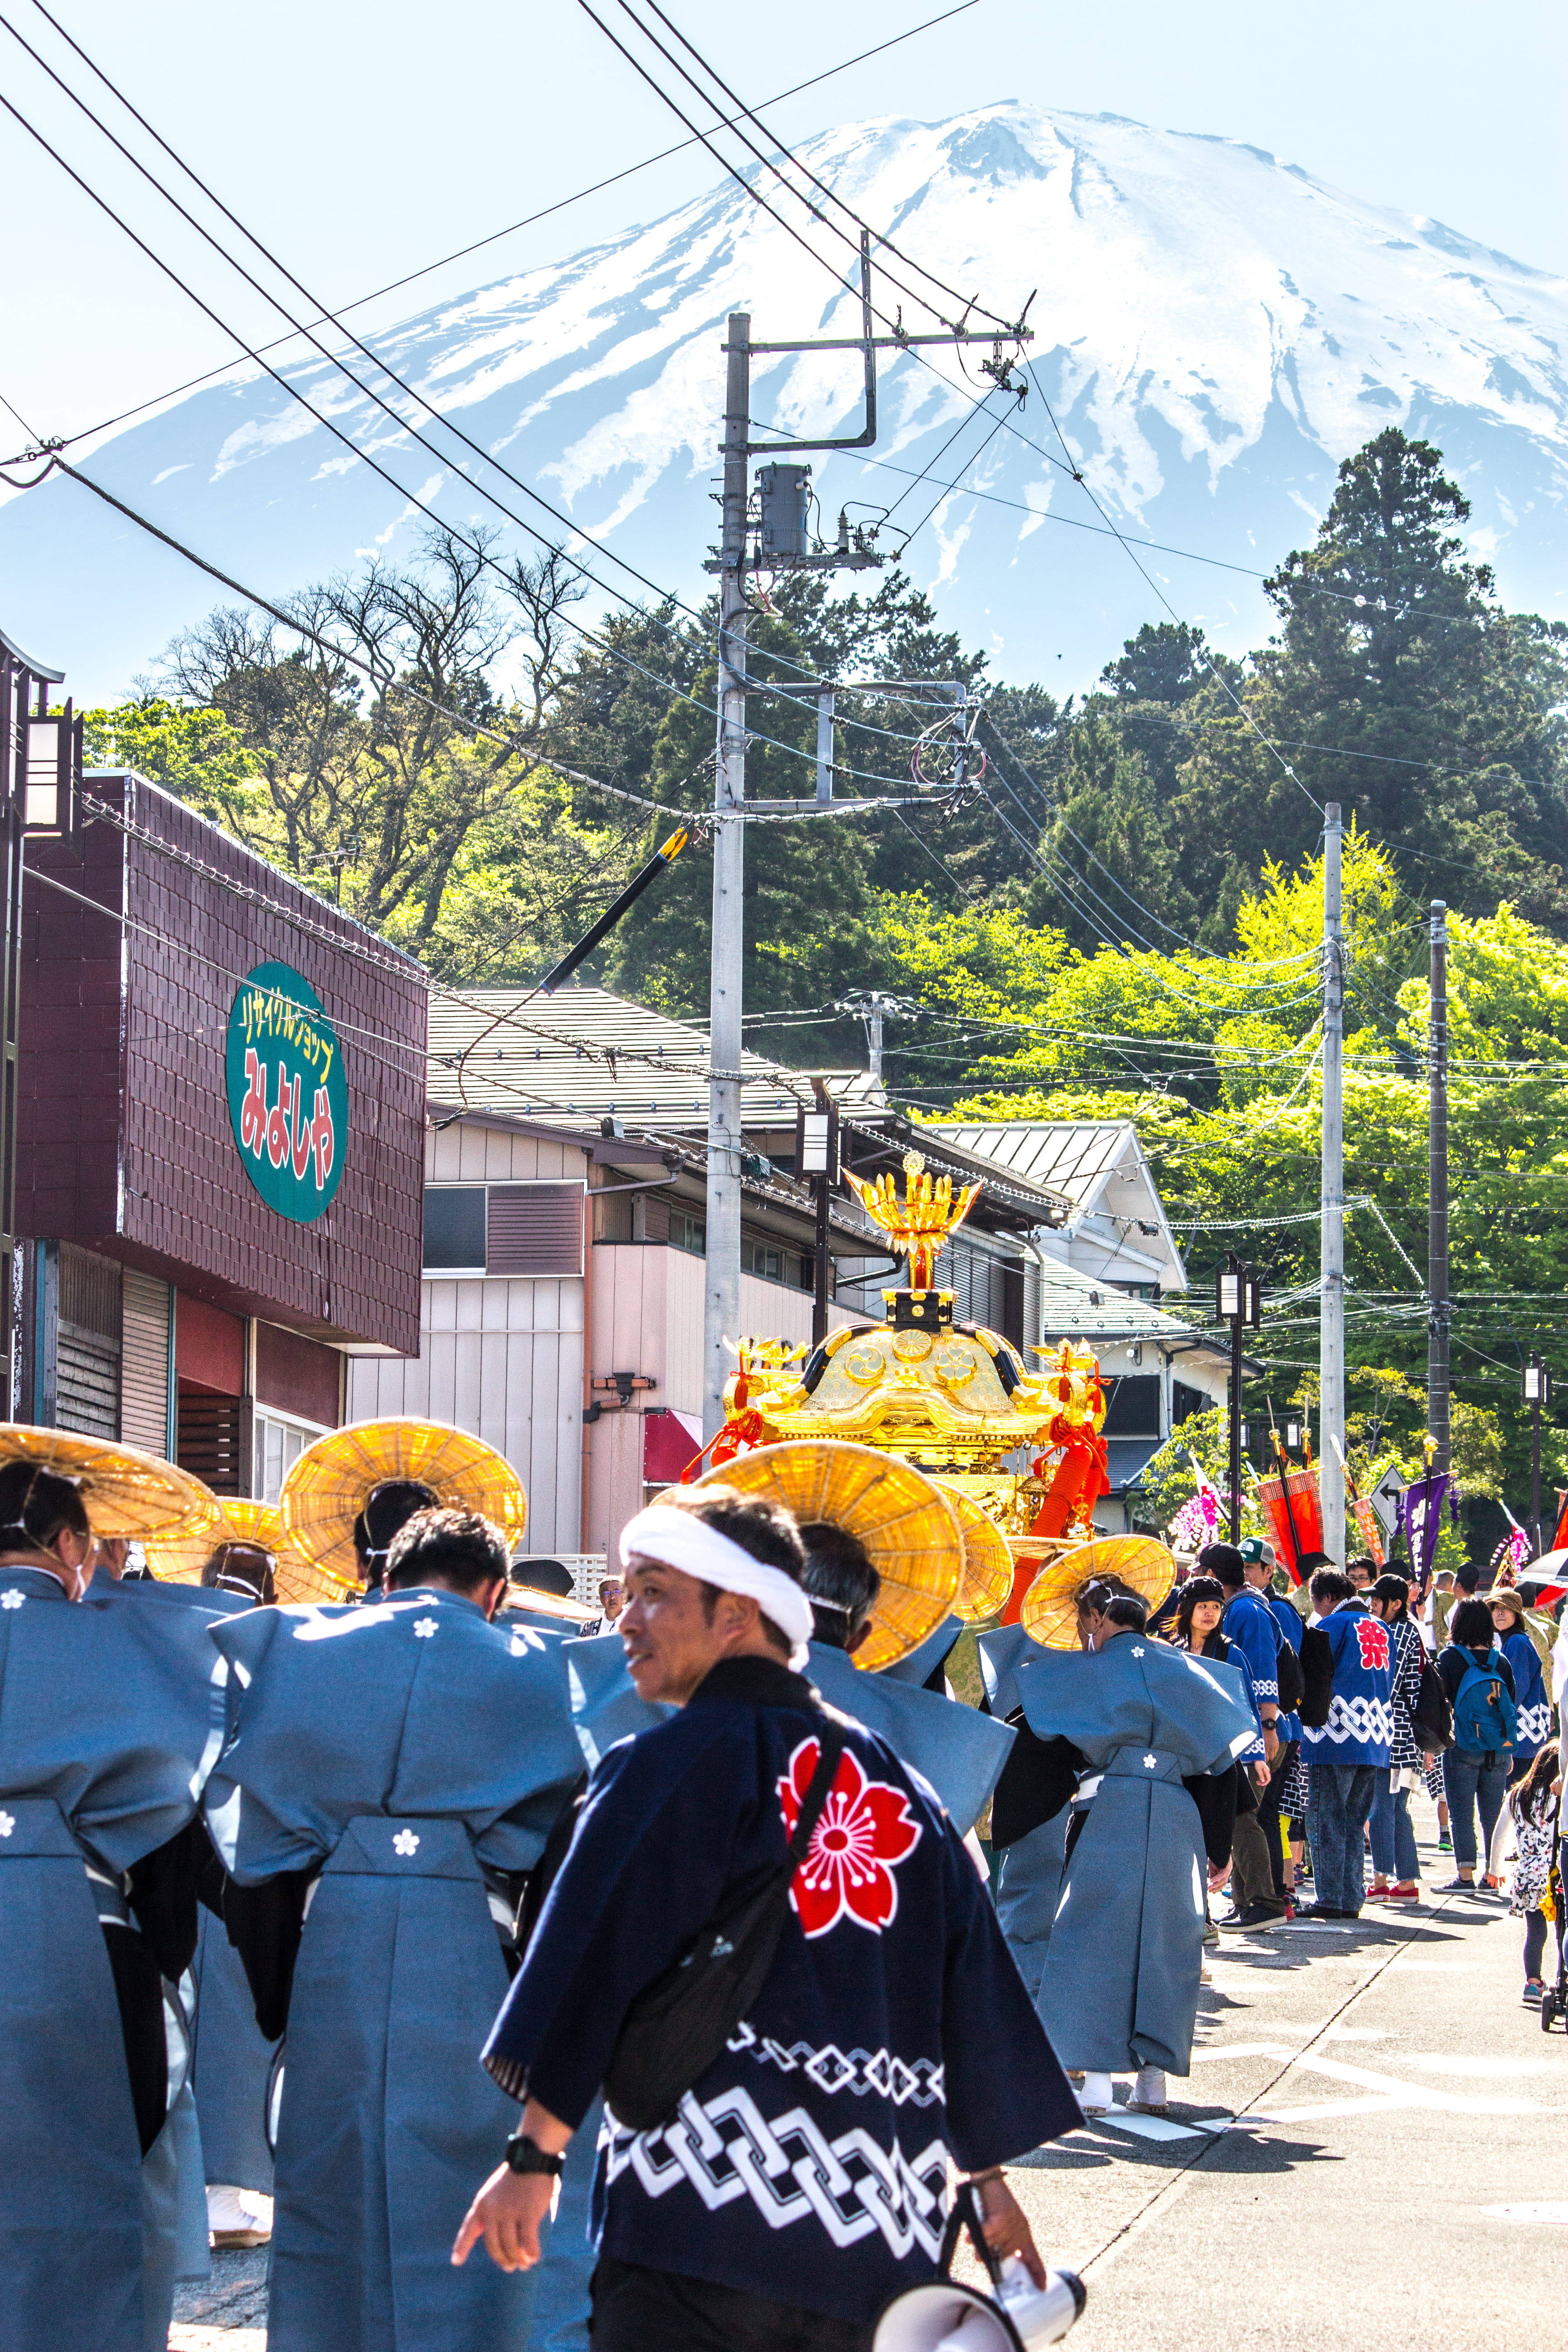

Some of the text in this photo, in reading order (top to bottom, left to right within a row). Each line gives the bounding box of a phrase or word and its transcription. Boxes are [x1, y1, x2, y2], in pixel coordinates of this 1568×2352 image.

[243, 986, 334, 1084] リサイクルショップ
[240, 1048, 334, 1191] みよしや
[1353, 1617, 1389, 1672] 祭
